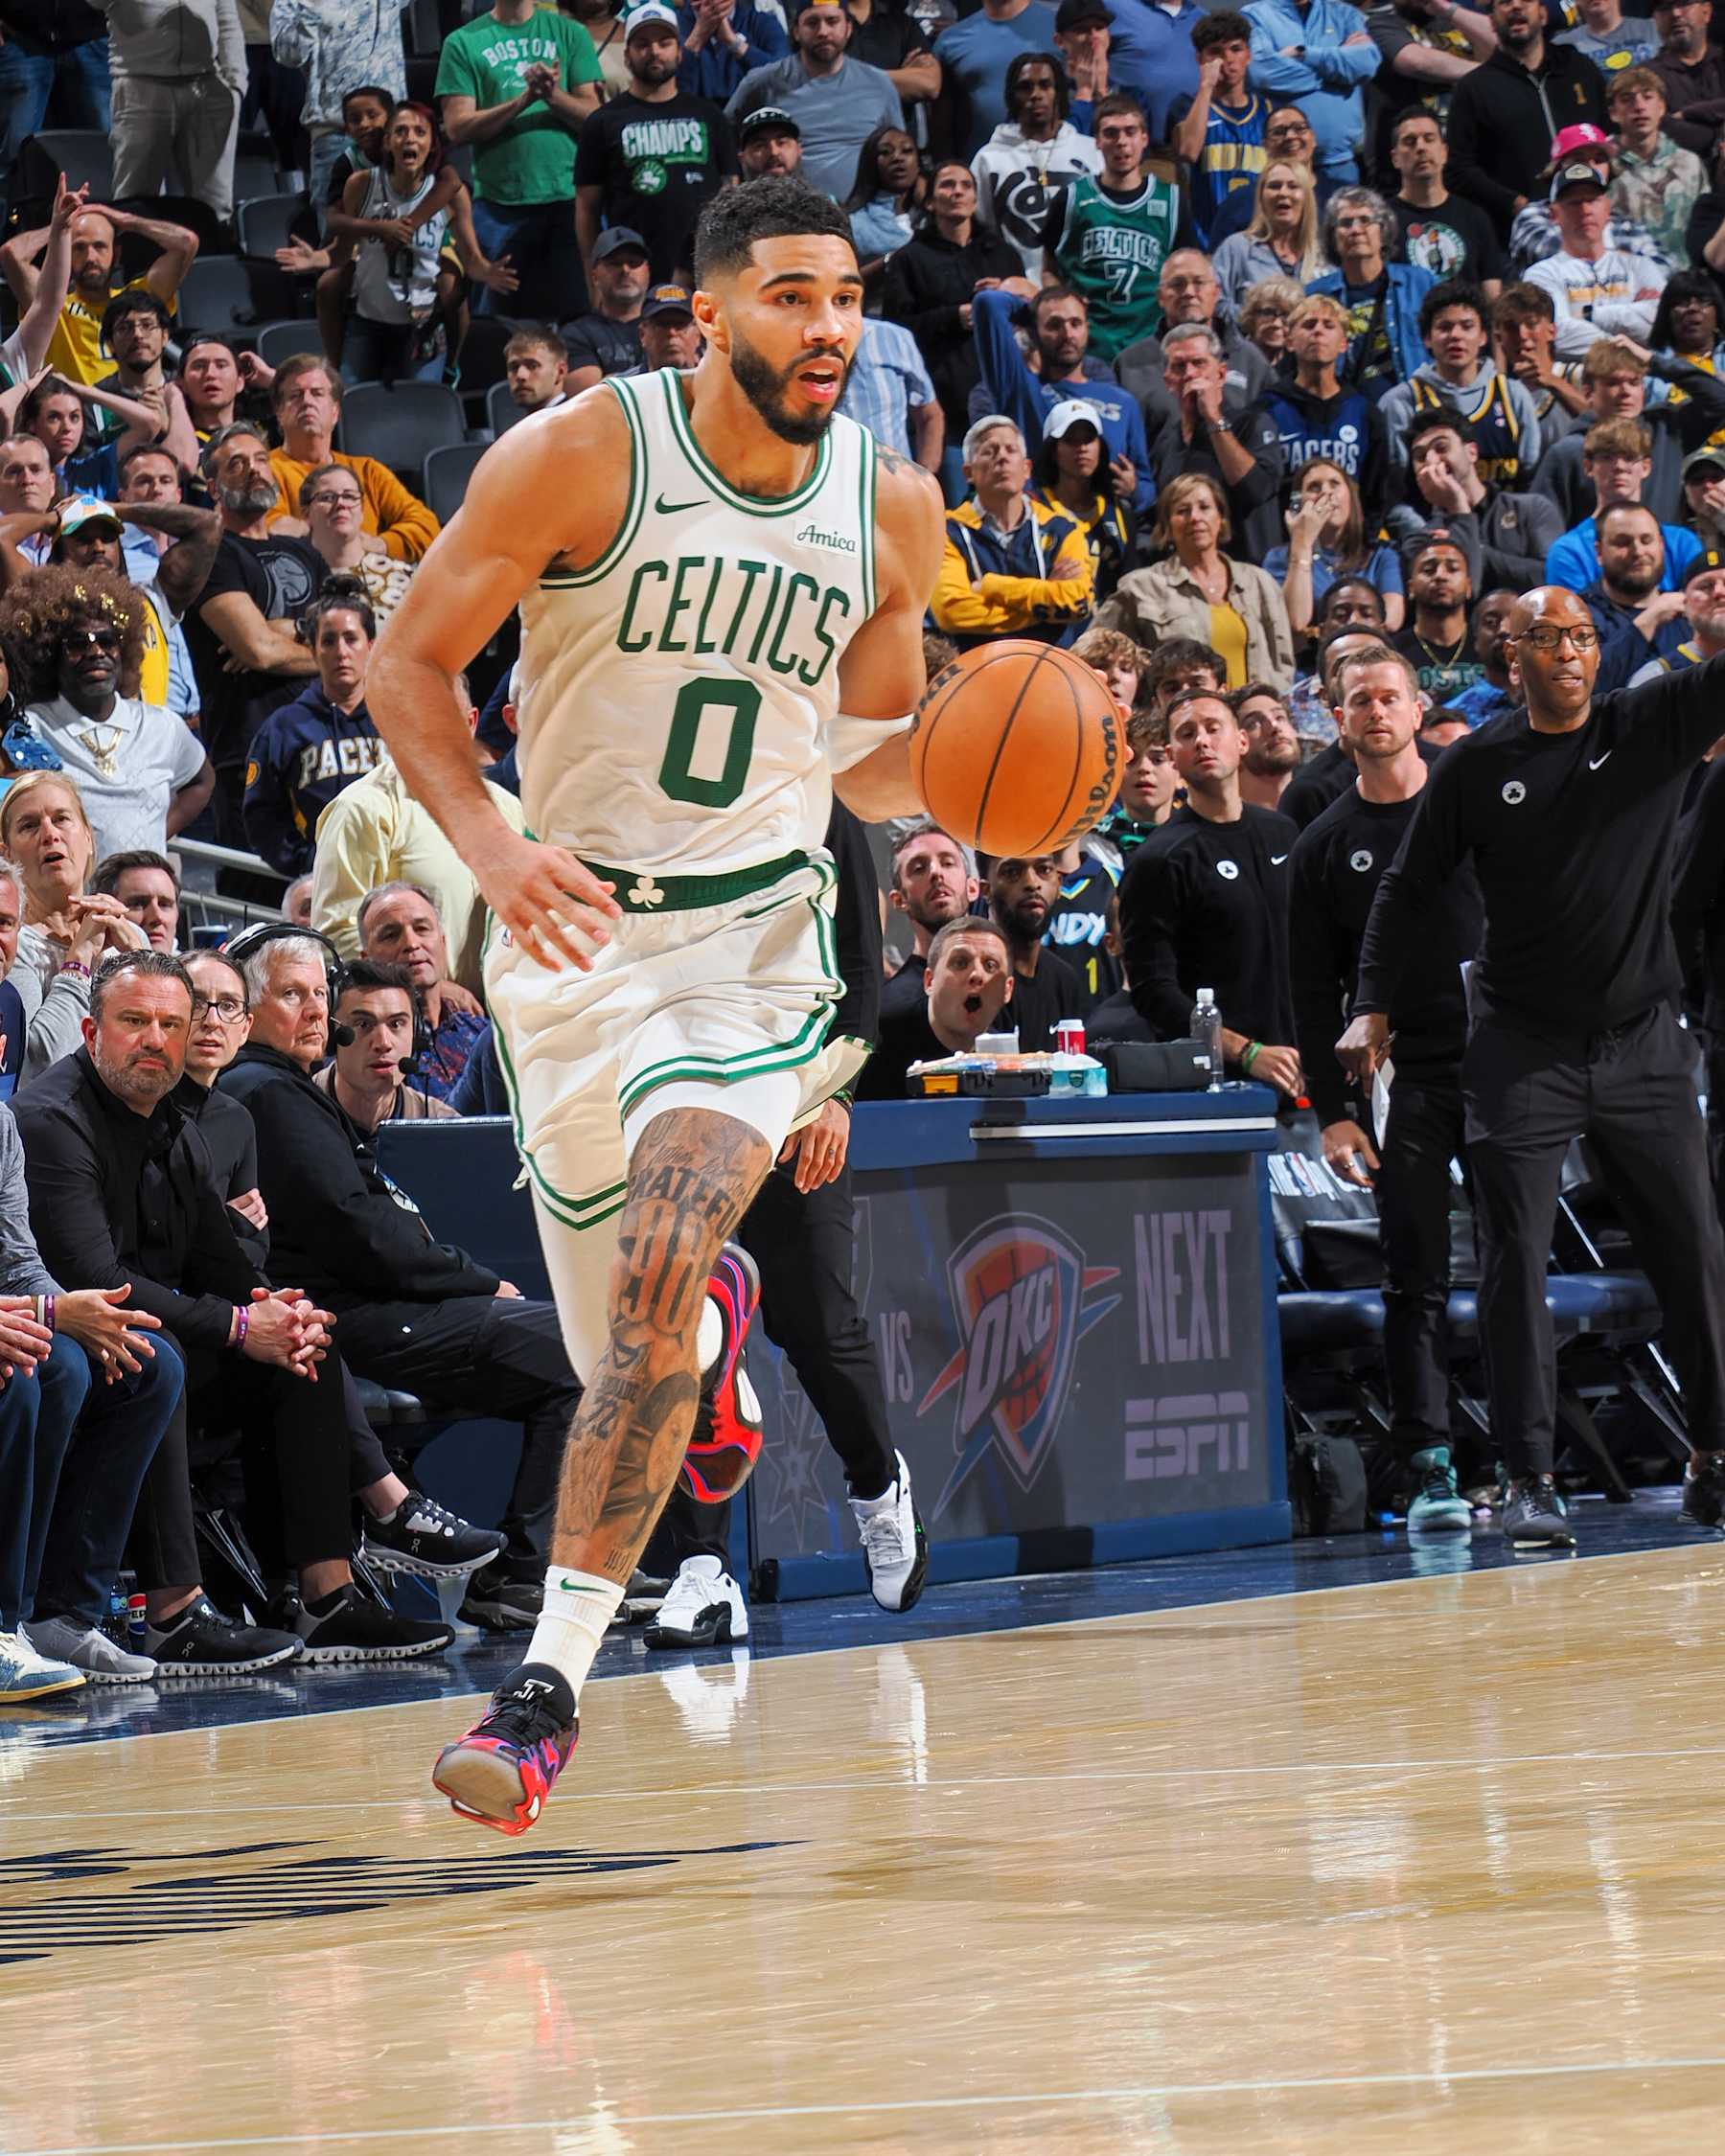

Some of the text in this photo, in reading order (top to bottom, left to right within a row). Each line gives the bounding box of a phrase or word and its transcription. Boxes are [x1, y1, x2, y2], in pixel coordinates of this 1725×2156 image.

[482, 37, 557, 68] BOSTON
[621, 121, 702, 159] CHAMPS
[1104, 260, 1140, 305] 7
[796, 524, 856, 553] Amica
[616, 556, 851, 687] CELTICS
[658, 677, 763, 808] 0
[1086, 957, 1097, 995] 1
[1133, 1209, 1232, 1365] NEXT
[879, 1310, 914, 1404] VS
[960, 1265, 1055, 1435] OKC
[1124, 1391, 1250, 1480] ESPN
